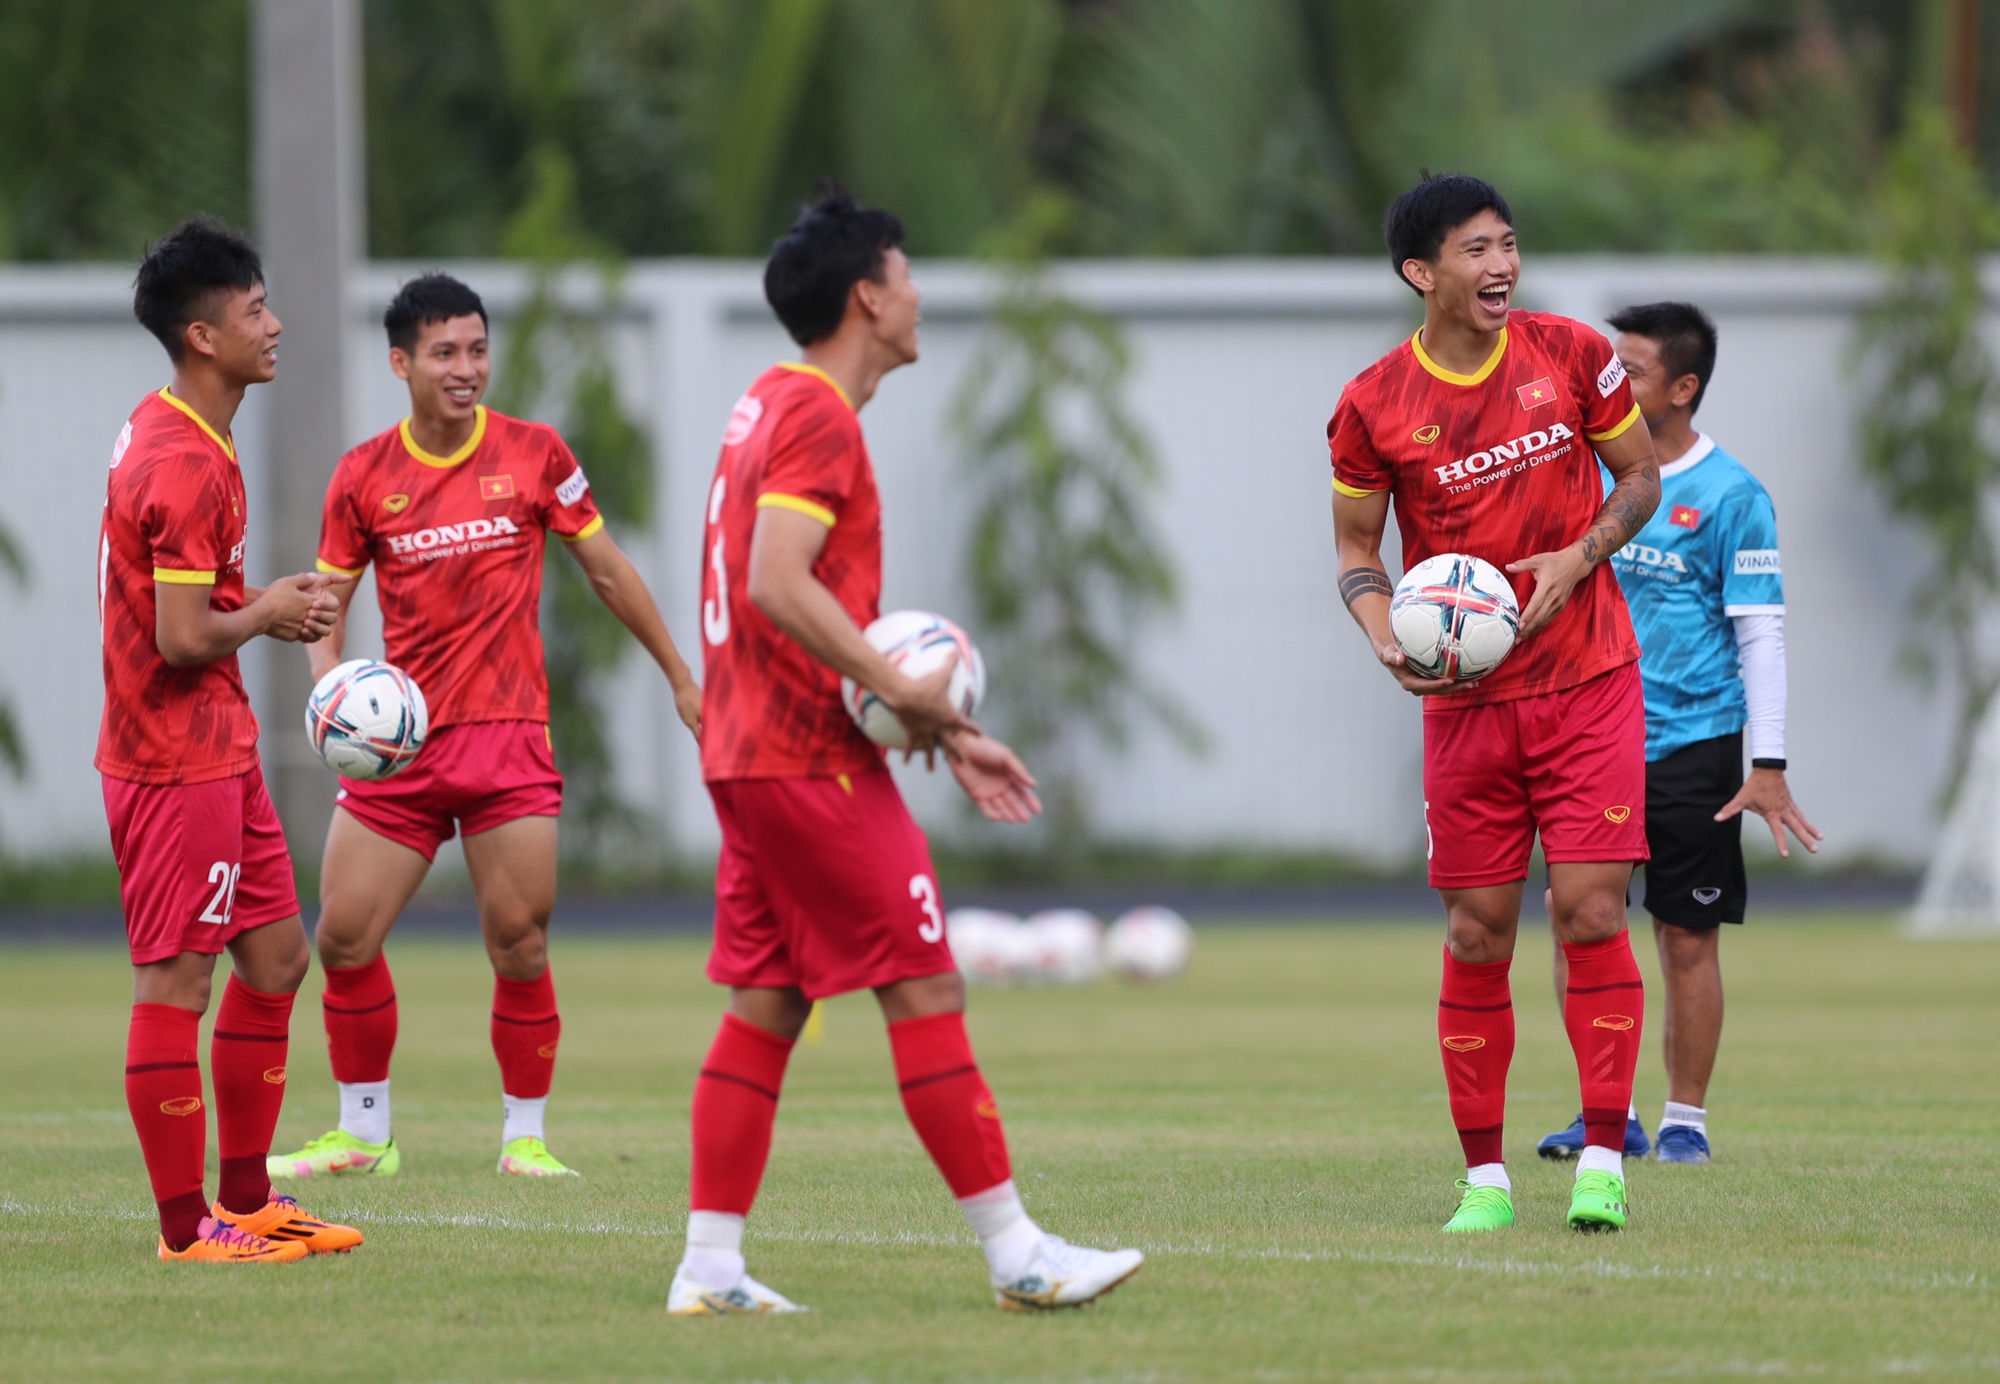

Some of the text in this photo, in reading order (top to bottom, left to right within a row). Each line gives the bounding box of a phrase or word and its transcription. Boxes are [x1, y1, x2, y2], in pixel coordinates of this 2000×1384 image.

[1434, 422, 1574, 485] HONDA
[1446, 443, 1571, 495] The Power of Dreams
[387, 516, 519, 555] HONDA
[399, 536, 515, 565] The Power of Dreams
[1610, 543, 1689, 573] NDA
[1622, 563, 1635, 573] of
[1636, 565, 1680, 584] Dreams
[198, 861, 241, 925] 20
[908, 874, 943, 944] 3
